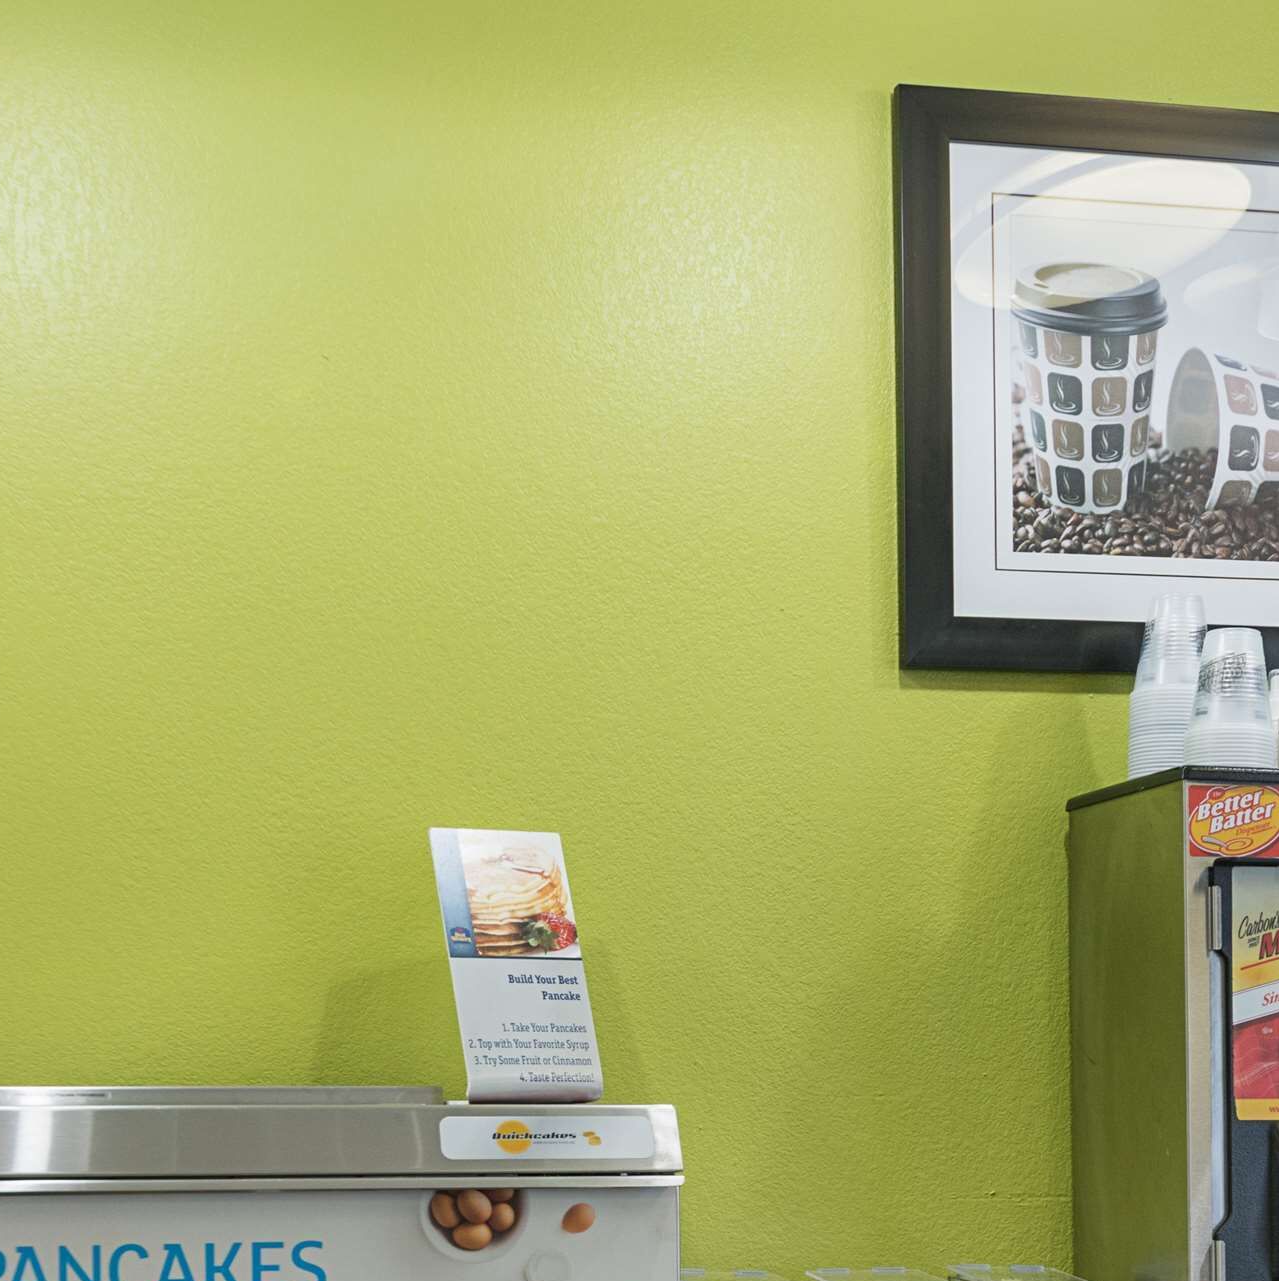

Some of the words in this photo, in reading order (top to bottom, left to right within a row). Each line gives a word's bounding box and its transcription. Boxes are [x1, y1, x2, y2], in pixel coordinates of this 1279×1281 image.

[1197, 789, 1264, 820] Better
[1209, 802, 1276, 834] Batter
[508, 973, 534, 984] Build
[535, 974, 557, 985] Your
[558, 975, 579, 985] Best
[541, 990, 581, 1001] Pancake
[502, 1023, 510, 1032] 1.
[510, 1022, 530, 1032] Take
[530, 1022, 549, 1033] Your
[550, 1023, 588, 1033] Pancakes
[468, 1039, 477, 1049] 2.
[478, 1038, 493, 1051] Top
[493, 1038, 513, 1049] with
[514, 1039, 532, 1049] Your
[533, 1039, 566, 1049] Favorite
[566, 1039, 590, 1052] Syrup
[474, 1055, 483, 1065] 3.
[483, 1055, 497, 1067] Try
[498, 1055, 520, 1065] Some
[521, 1055, 542, 1065] Fruit
[542, 1057, 552, 1065] or
[552, 1055, 593, 1066] Cinnamon
[519, 1072, 528, 1082] 4.
[528, 1071, 550, 1083] Taste
[550, 1071, 595, 1083] Perfection!
[492, 1131, 577, 1140] Quickcakes
